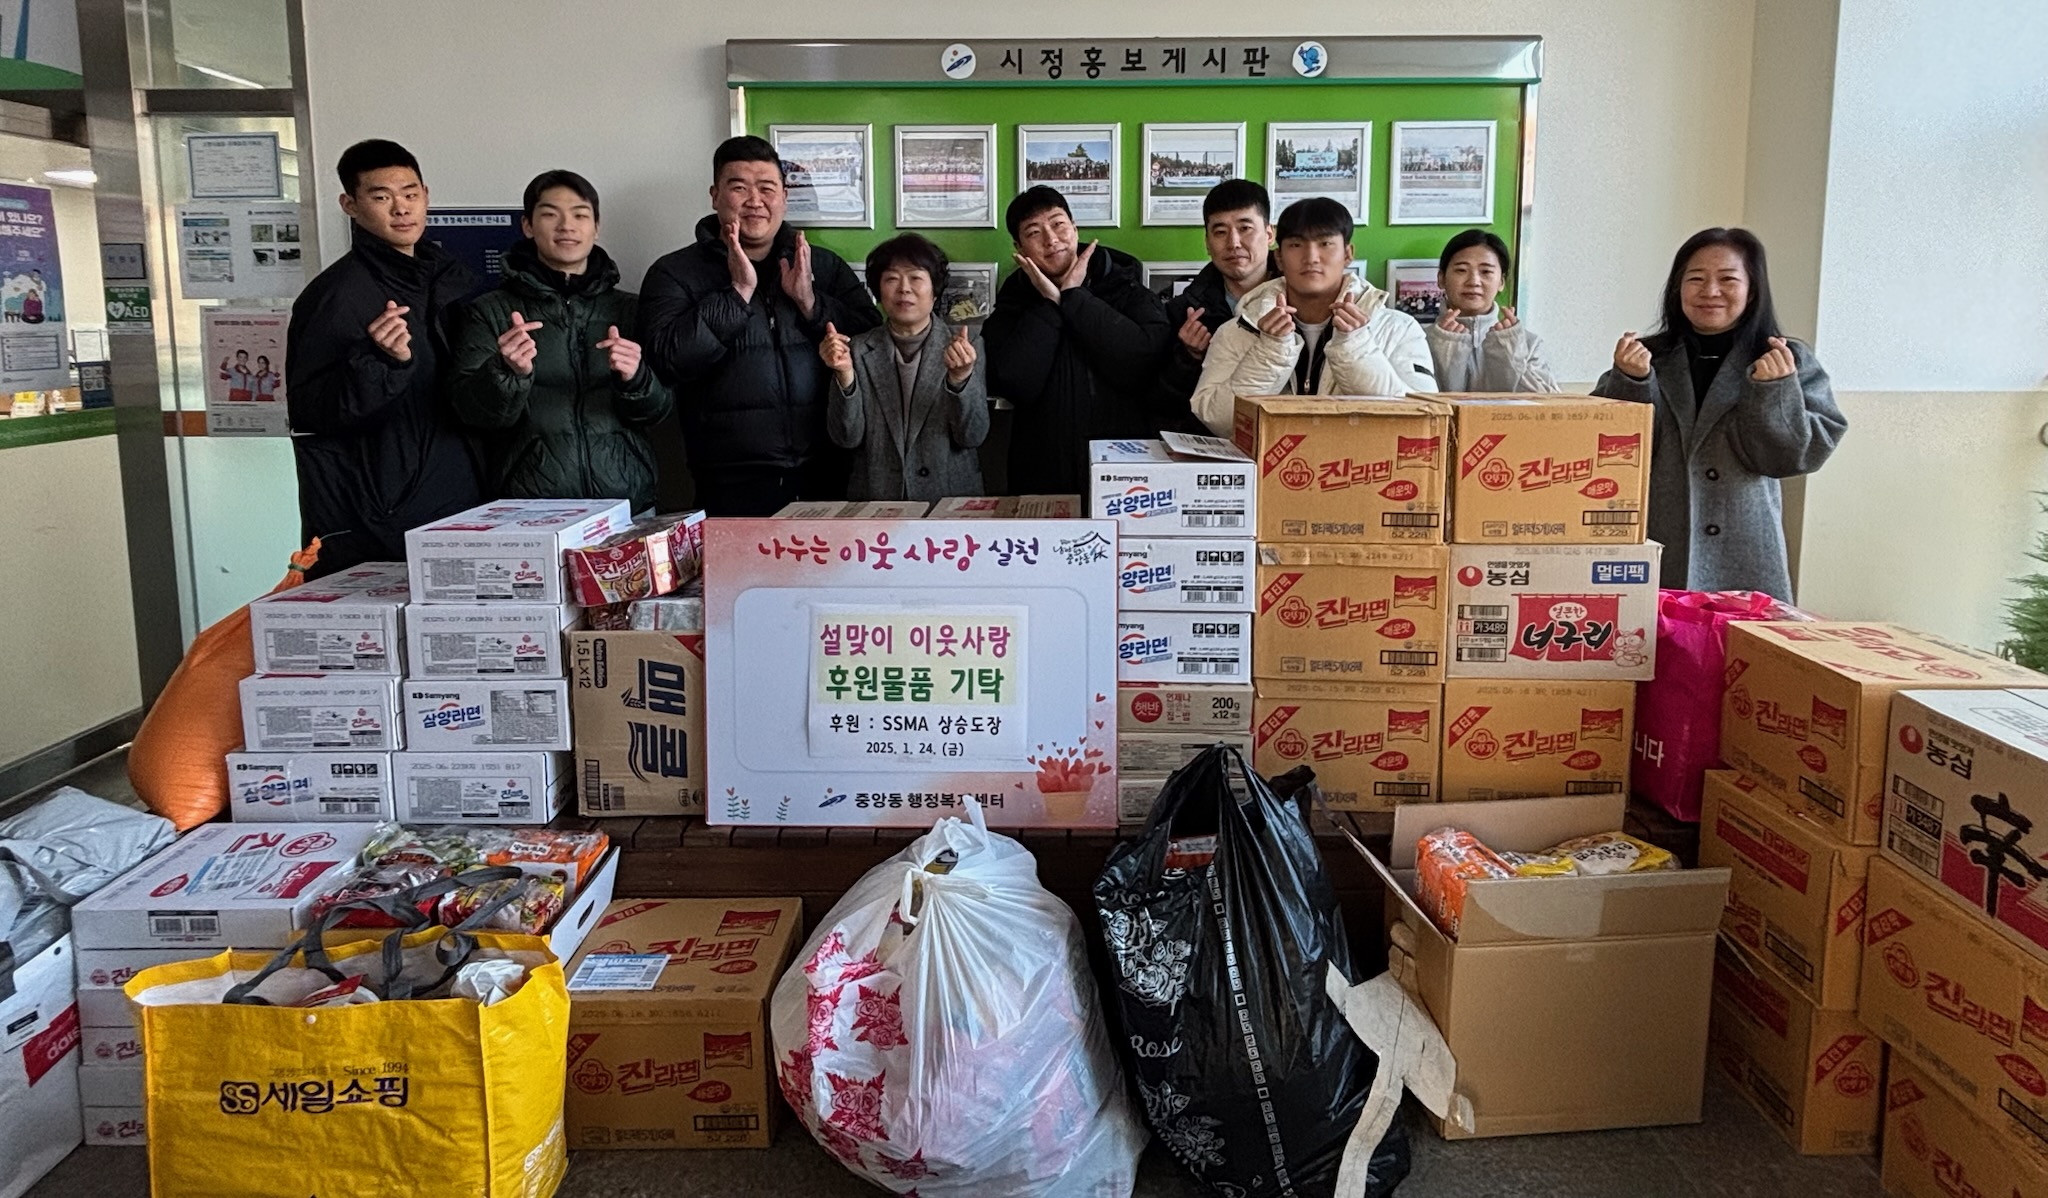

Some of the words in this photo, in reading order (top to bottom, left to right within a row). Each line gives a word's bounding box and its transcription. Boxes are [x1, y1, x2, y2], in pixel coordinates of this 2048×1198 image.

[124, 306, 149, 318] AED
[1113, 475, 1149, 483] Samyang
[1318, 458, 1393, 492] 진라면
[1518, 457, 1593, 492] 진라면
[1106, 489, 1173, 517] 삼양라면
[758, 534, 831, 564] 나누는
[839, 532, 897, 571] 이웃
[903, 532, 980, 571] 사랑
[988, 537, 1040, 566] 실천
[595, 552, 642, 581] 진라면
[1119, 564, 1172, 588] 양라면
[1486, 570, 1530, 586] 농심
[1597, 565, 1646, 581] 멀티팩
[1315, 596, 1389, 630] 진라면
[1552, 605, 1585, 618] 얼큰한
[820, 624, 894, 657] 설맞이
[909, 625, 1010, 658] 이웃사랑
[1474, 622, 1507, 633] 가3489
[1523, 621, 1612, 650] 너구리
[425, 692, 460, 700] Samyang
[826, 664, 934, 702] 후원물품
[950, 668, 1005, 702] 기탁
[422, 705, 482, 729] 삼양라면
[1134, 701, 1160, 716] 햇반
[1212, 697, 1240, 710] 200g
[620, 658, 688, 783] 맥콜
[829, 714, 859, 733] 후원
[882, 715, 929, 732] SSMA
[938, 715, 1002, 735] 상승도장
[1756, 700, 1810, 742] 진라면
[866, 742, 898, 755] 2025.
[903, 742, 913, 755] 1.
[919, 742, 937, 755] 24.
[942, 742, 964, 757] (금)
[1311, 729, 1384, 762] 진라면
[1503, 729, 1577, 762] 진라면
[248, 764, 284, 772] Samyang
[1926, 740, 1972, 780] 농심
[855, 792, 903, 809] 중앙동
[1960, 792, 2048, 918] 辛
[645, 937, 760, 965] 진라면
[112, 968, 139, 985] 진
[1925, 971, 2015, 1049] 진라면
[1130, 1035, 1183, 1058] Rose
[343, 1065, 376, 1077] Since
[382, 1062, 410, 1074] 1994
[617, 1059, 700, 1095] 진라면
[262, 1077, 409, 1114] 세일쇼핑
